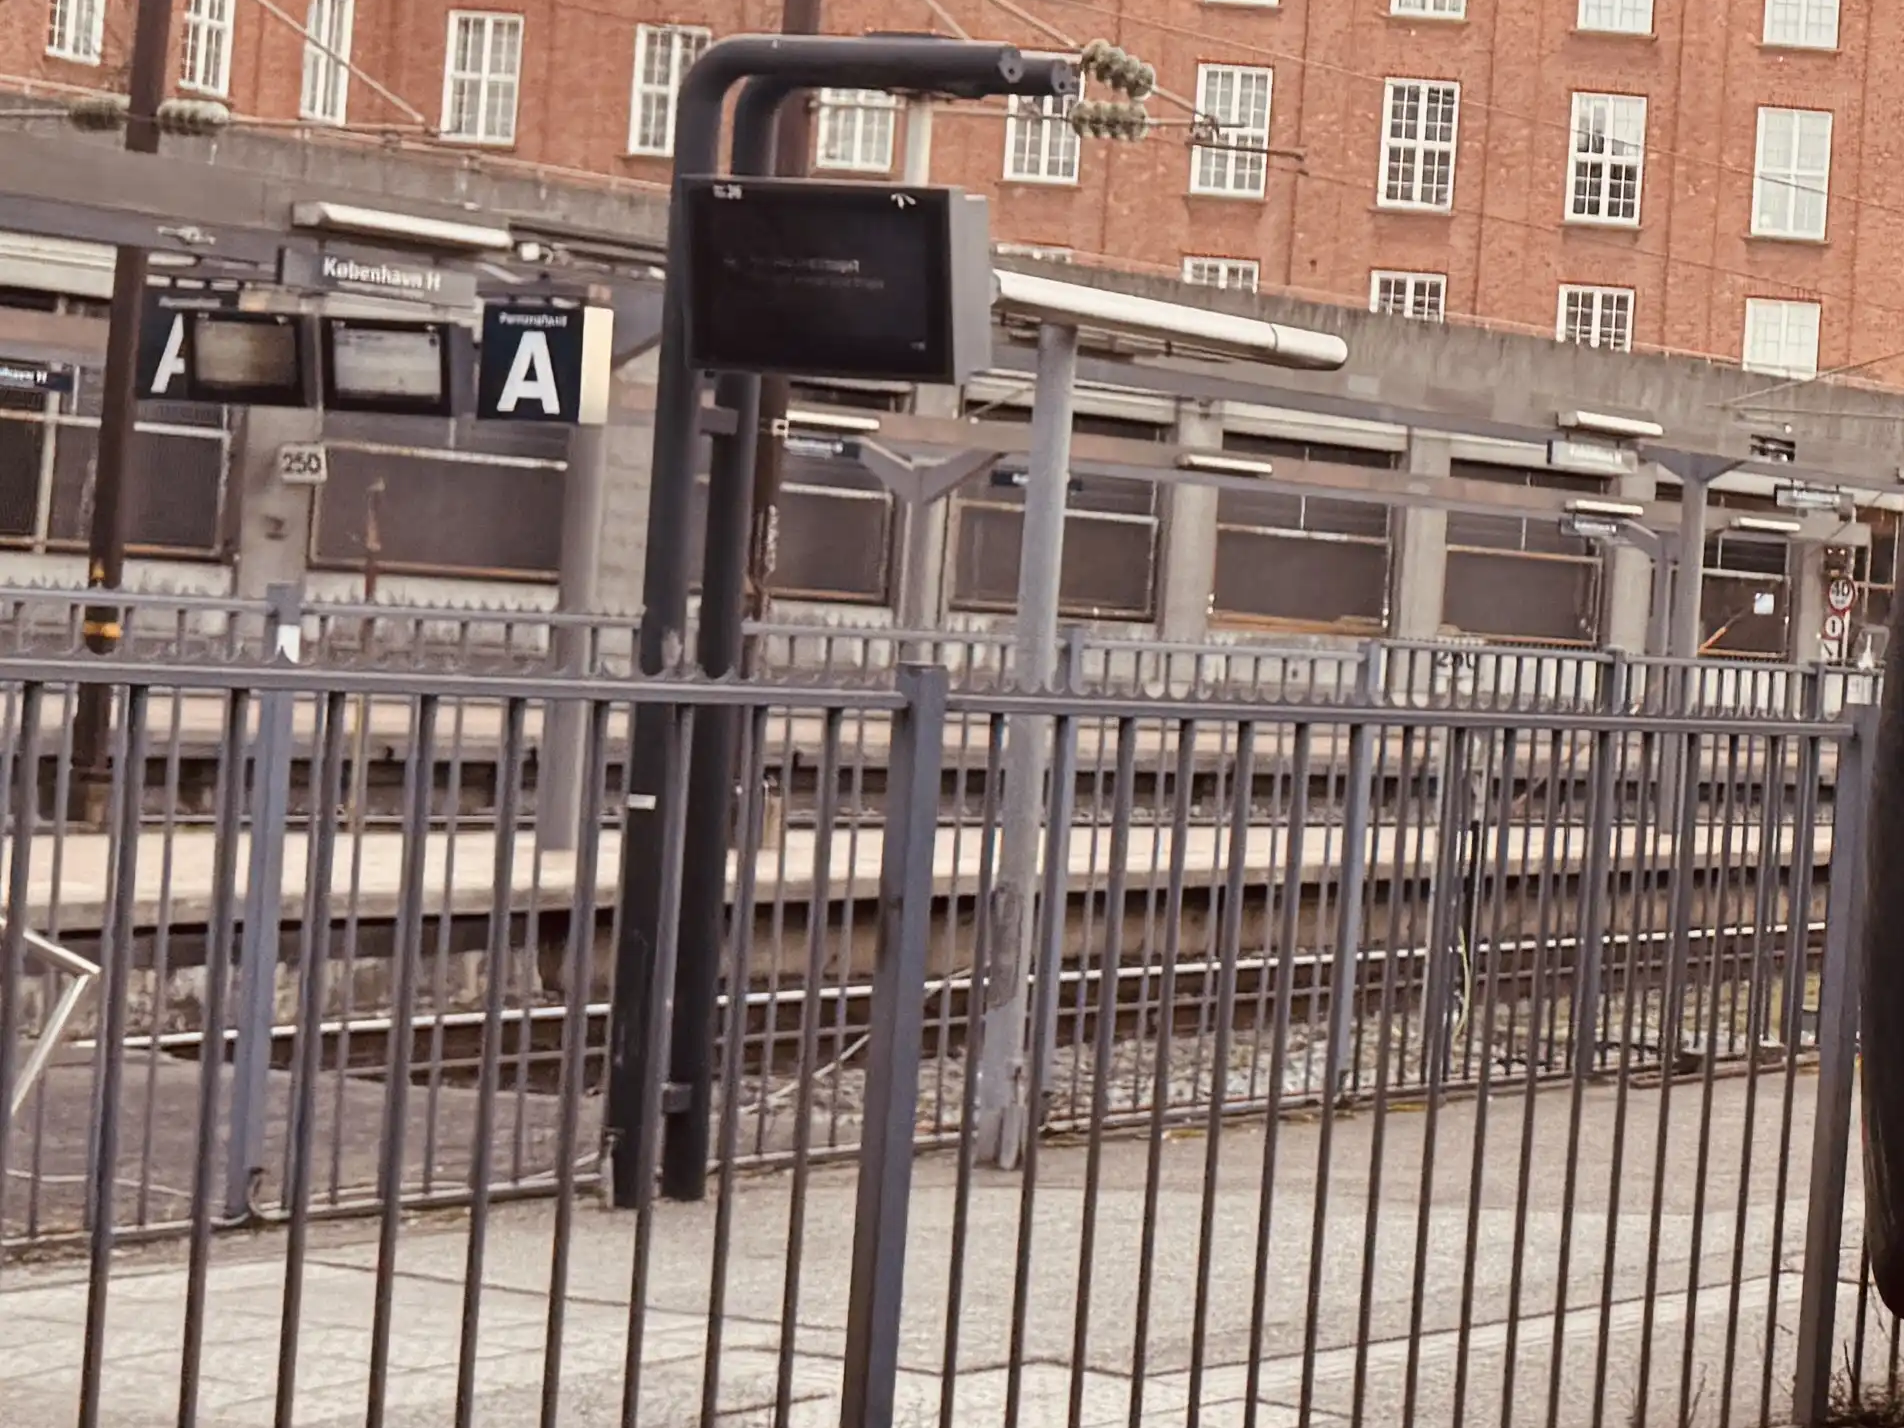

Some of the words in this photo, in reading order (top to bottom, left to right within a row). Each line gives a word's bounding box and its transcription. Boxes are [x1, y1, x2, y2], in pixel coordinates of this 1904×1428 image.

[323, 256, 422, 289] København
[496, 331, 560, 415] A
[283, 453, 321, 474] 250
